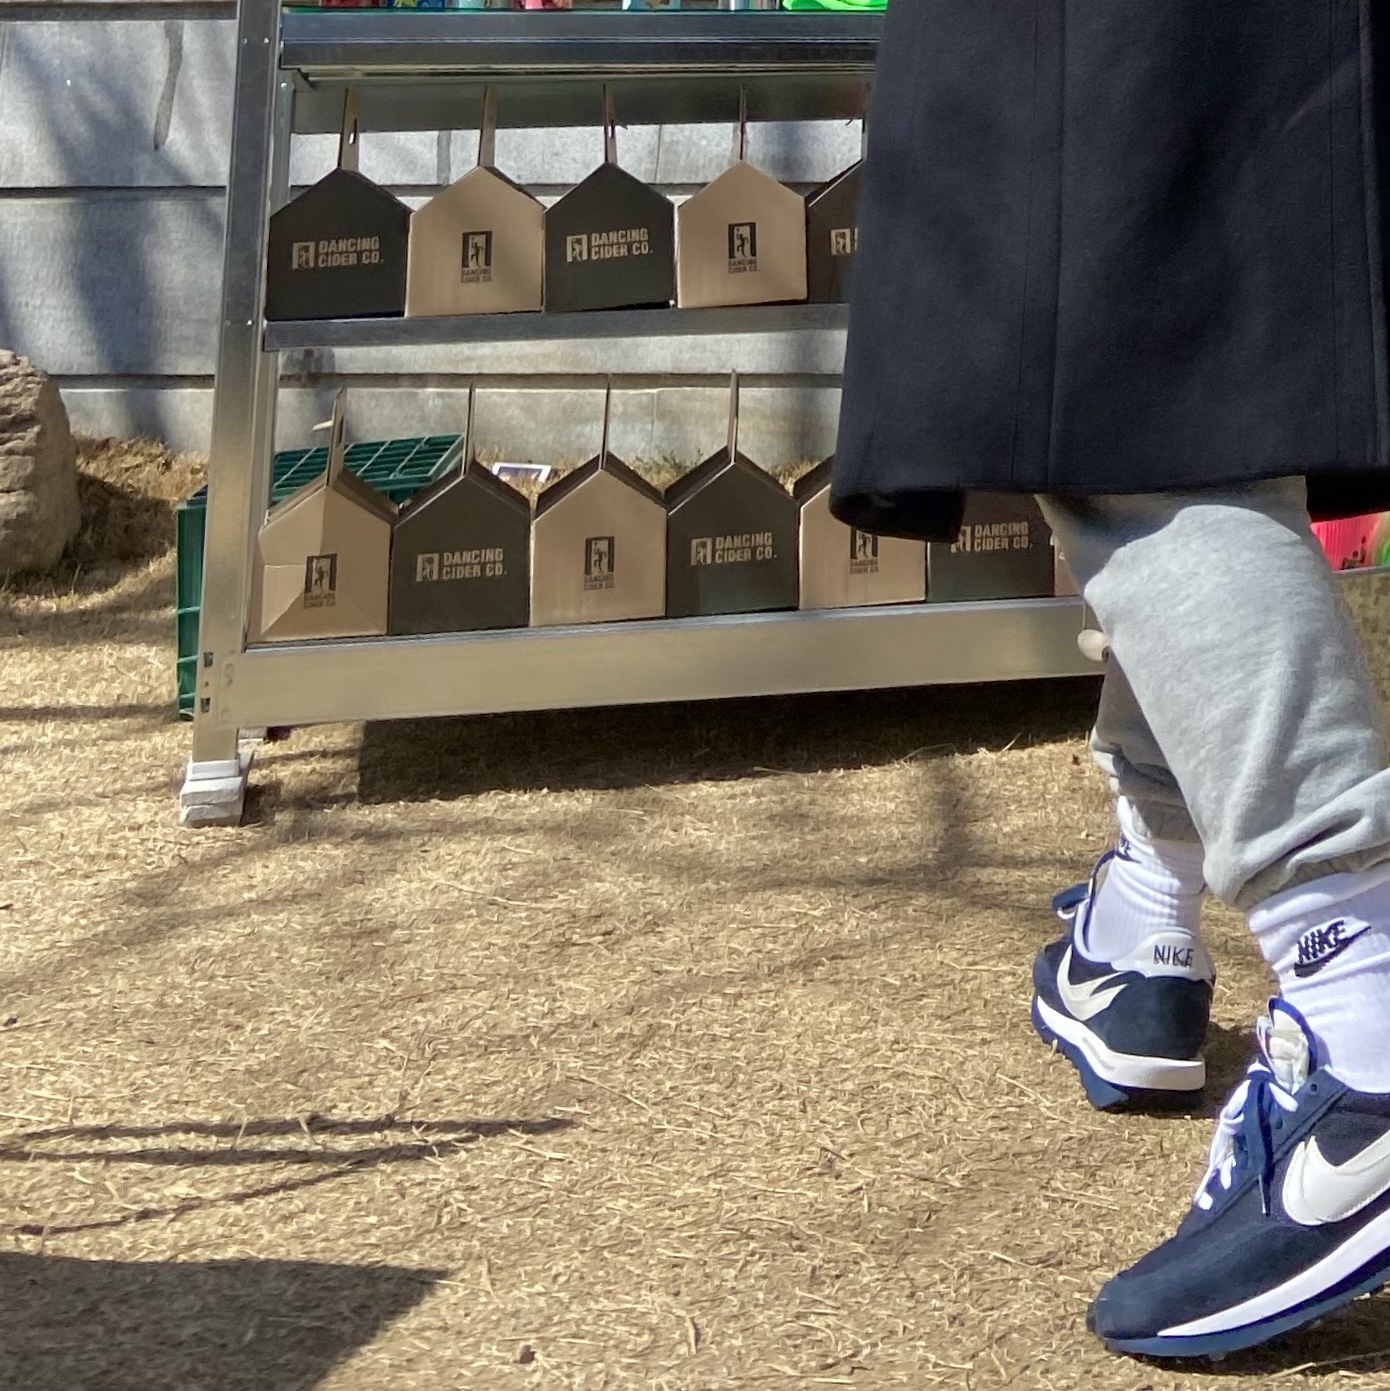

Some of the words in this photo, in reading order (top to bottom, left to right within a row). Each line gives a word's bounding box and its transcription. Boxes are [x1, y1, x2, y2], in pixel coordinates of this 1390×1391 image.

[318, 236, 380, 254] DANCING
[591, 228, 648, 246] DANCING
[317, 252, 357, 268] CIDER
[362, 250, 384, 265] CO.
[591, 243, 628, 260] CIDER
[631, 241, 654, 255] CO.
[974, 521, 1029, 538] DANCING
[715, 531, 773, 549] DANCING
[974, 537, 1009, 552] CIDER
[443, 548, 504, 566] DANCING
[715, 546, 752, 564] CIDER
[756, 546, 778, 561] CO.
[442, 562, 481, 580] CIDER
[485, 562, 508, 577] CO.
[1297, 920, 1347, 963] NIKE
[1153, 944, 1194, 968] NIKE
